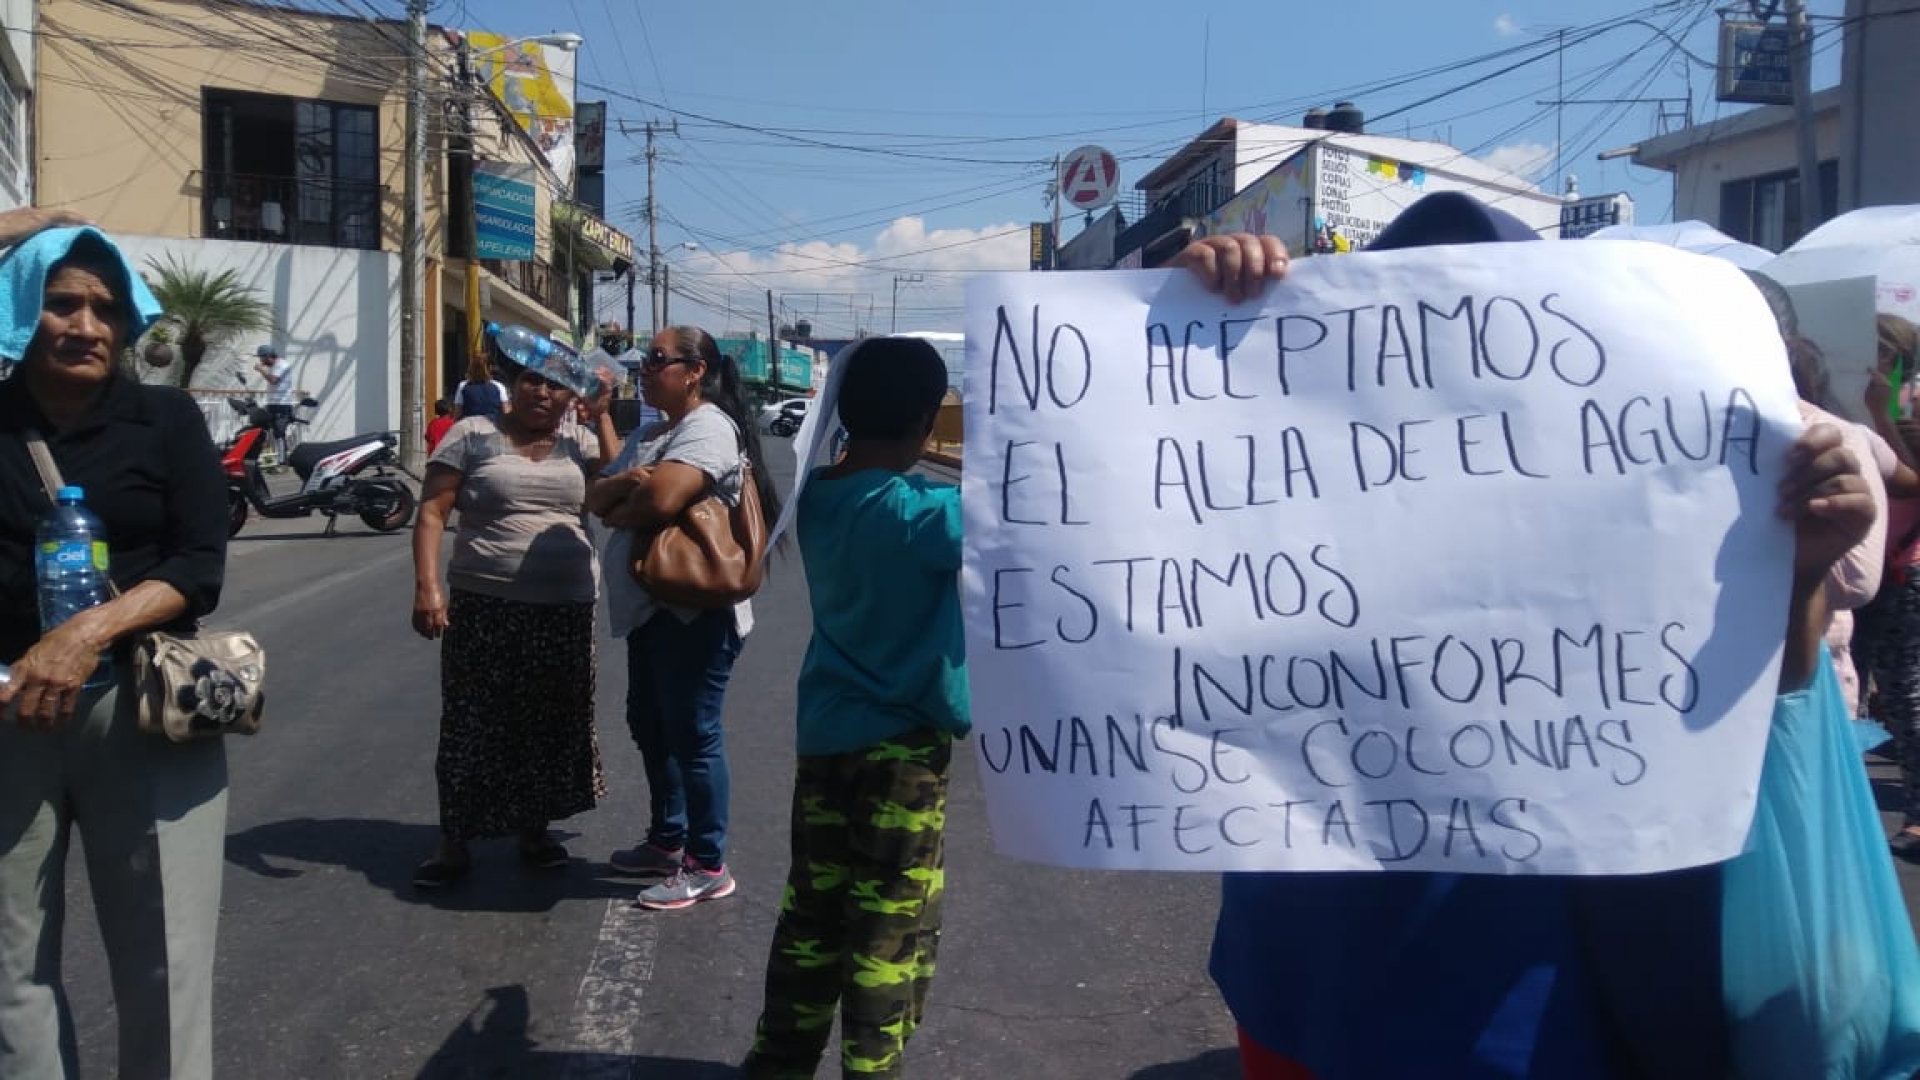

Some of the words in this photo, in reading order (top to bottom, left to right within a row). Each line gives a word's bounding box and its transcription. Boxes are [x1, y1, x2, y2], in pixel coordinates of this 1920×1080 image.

[1322, 172, 1350, 188] COPIAS
[1322, 185, 1348, 200] LONAS
[989, 304, 1092, 415] NO
[1146, 293, 1607, 406] ACEPTAMOS
[1002, 440, 1091, 525] EL
[1154, 426, 1320, 524] ALZA
[1349, 419, 1434, 492] DE
[1457, 411, 1551, 479] EL
[1580, 387, 1761, 476] AGUA
[993, 545, 1360, 650] ESTAMOS
[1172, 621, 1699, 729] INCONFORMES
[1302, 714, 1646, 787] COLONIAS
[1084, 797, 1541, 862] AFECTADAS
